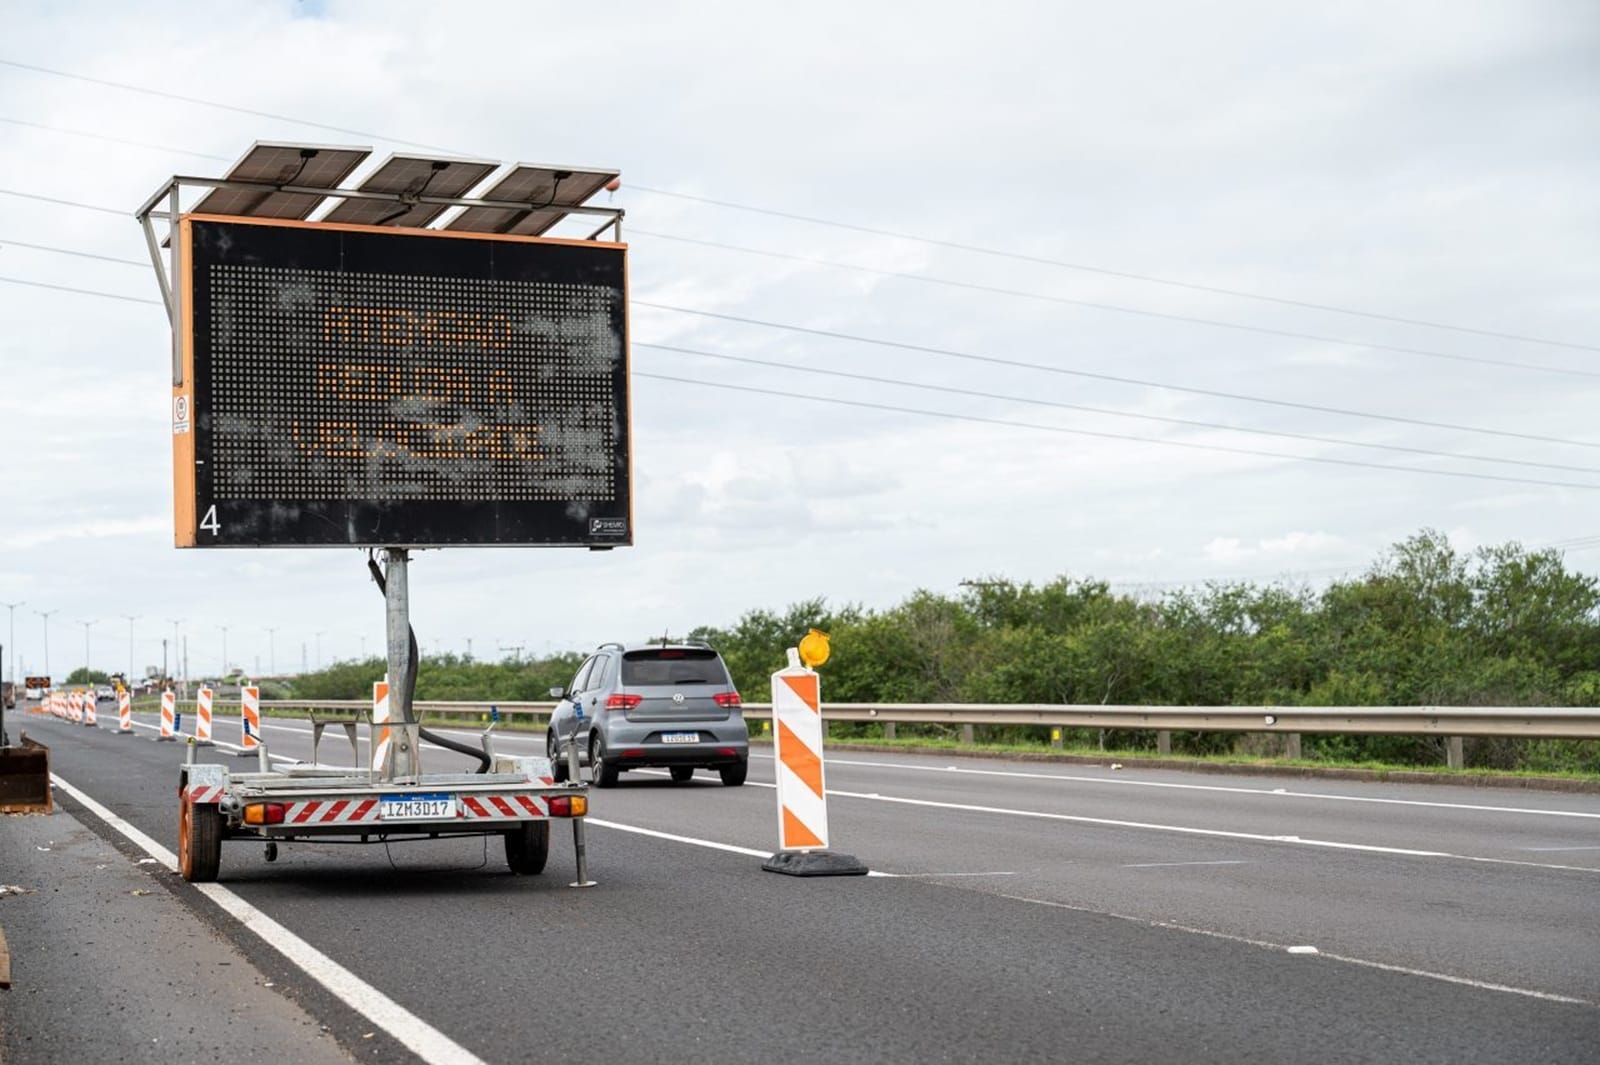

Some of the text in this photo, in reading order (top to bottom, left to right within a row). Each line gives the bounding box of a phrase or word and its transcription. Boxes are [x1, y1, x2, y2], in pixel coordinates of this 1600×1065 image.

[319, 364, 513, 404] REDUZA A
[292, 421, 544, 459] VELOCIDADE
[200, 504, 221, 536] 4
[387, 801, 449, 817] IZM3D17
